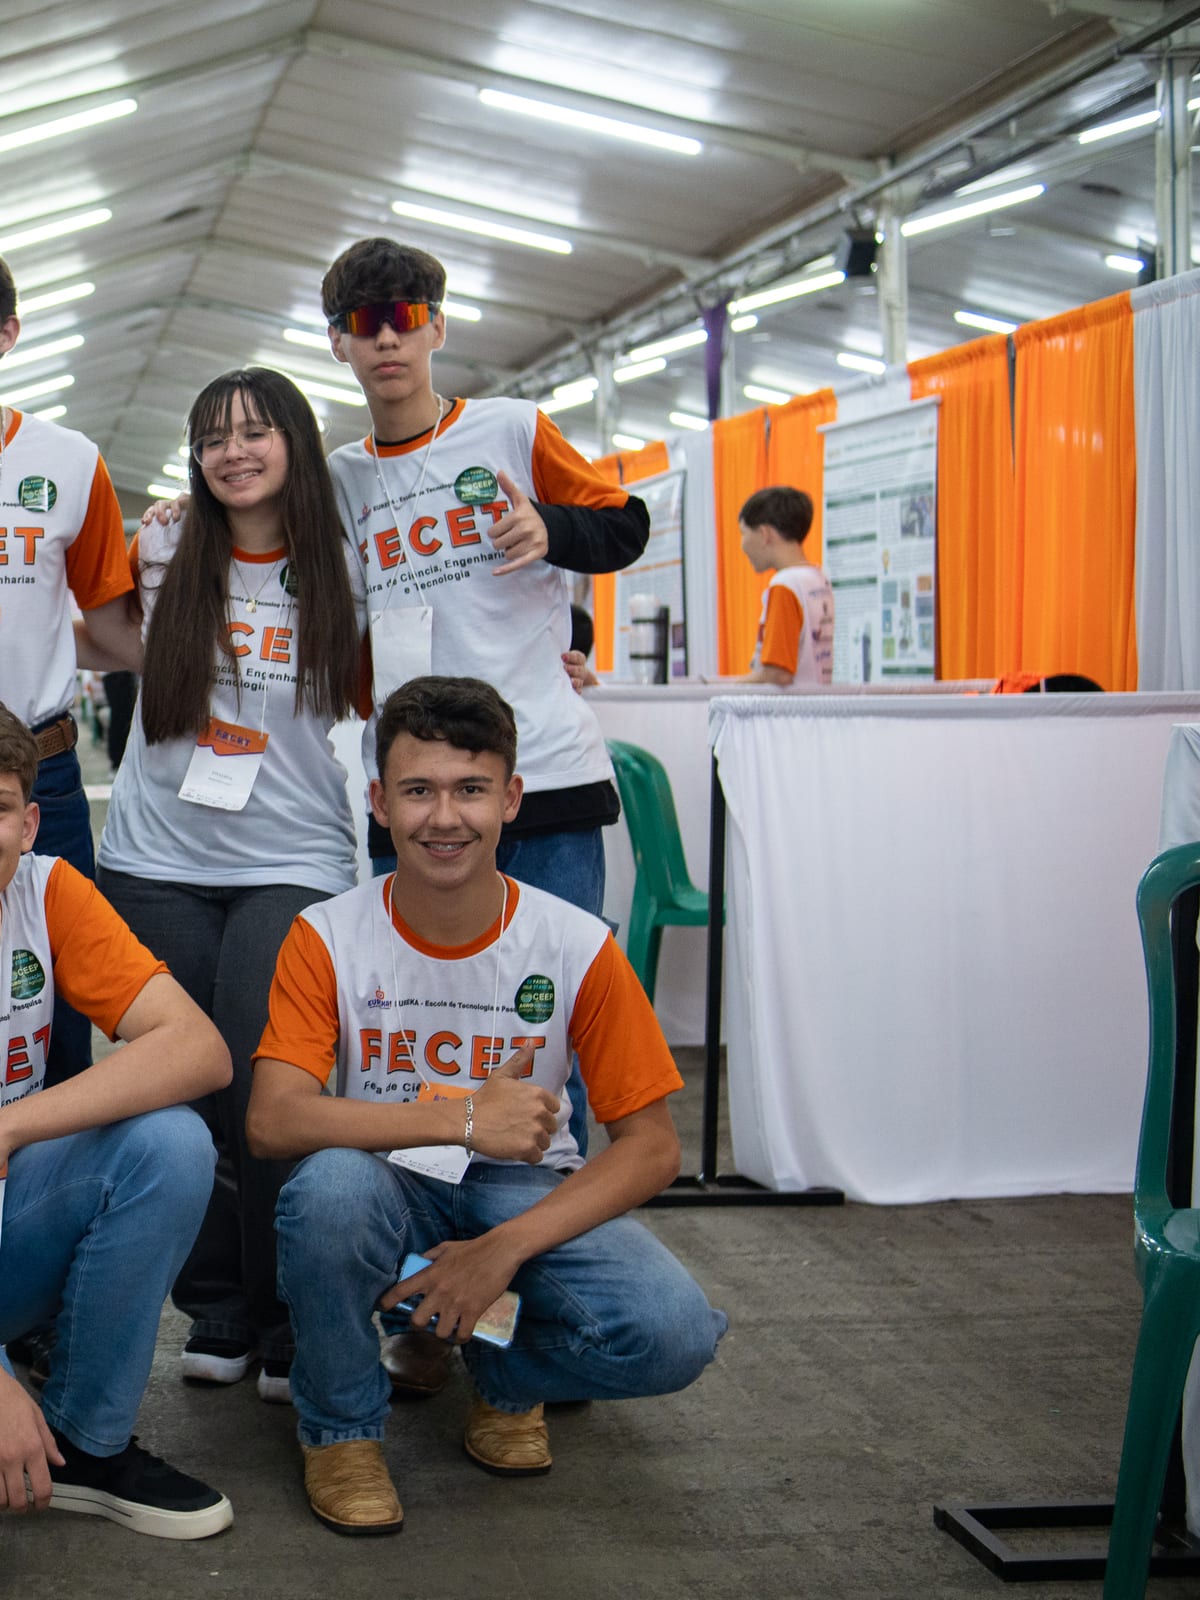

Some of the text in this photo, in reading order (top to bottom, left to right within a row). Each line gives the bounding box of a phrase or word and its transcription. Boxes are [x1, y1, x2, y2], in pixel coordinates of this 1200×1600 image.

[444, 550, 506, 569] Engenhari
[404, 586, 411, 594] e
[17, 963, 39, 976] CEEP
[532, 992, 554, 1001] CEEP
[12, 998, 43, 1013] Pesquisa
[458, 1002, 495, 1012] Tecnologia
[359, 1028, 546, 1080] FECET
